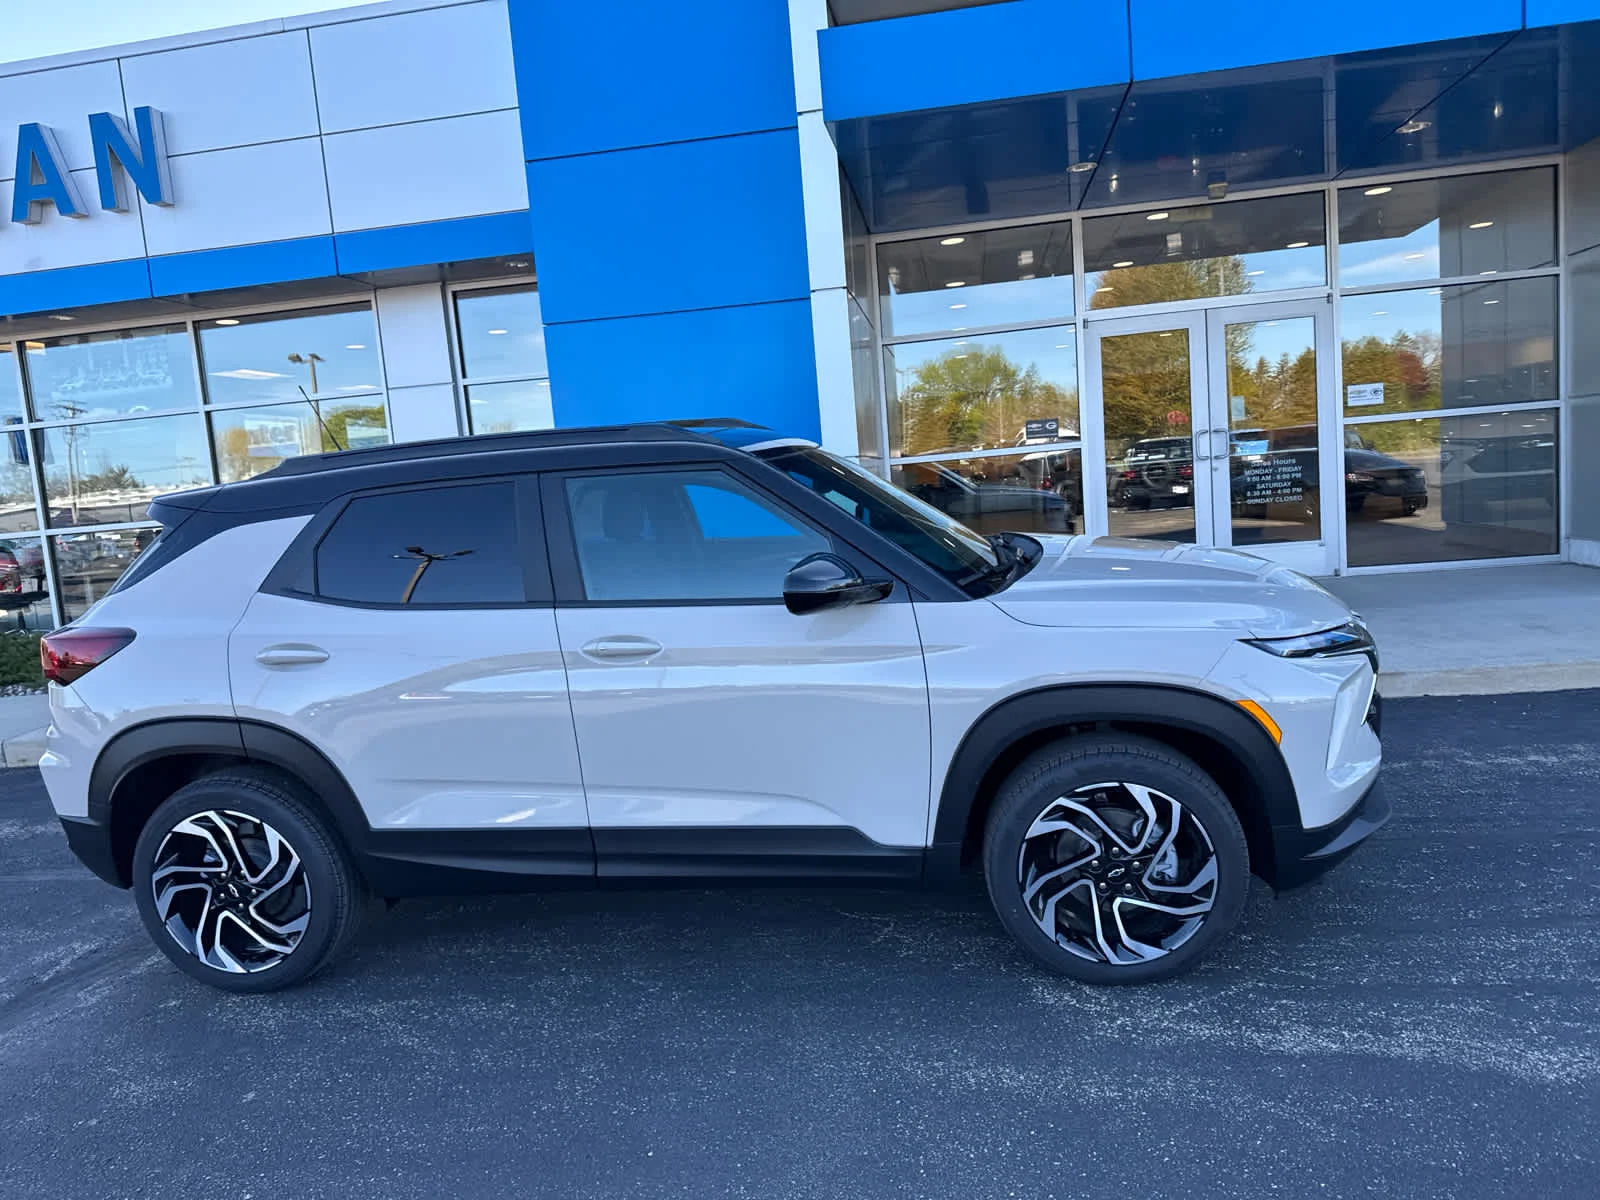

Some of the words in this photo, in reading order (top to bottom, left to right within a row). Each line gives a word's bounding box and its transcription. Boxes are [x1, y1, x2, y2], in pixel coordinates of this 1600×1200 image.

[1244, 468, 1272, 476] MONDAY
[1278, 465, 1303, 473] FRIDAY
[1256, 482, 1291, 490] SATURDAY
[1275, 495, 1303, 503] CLOSED
